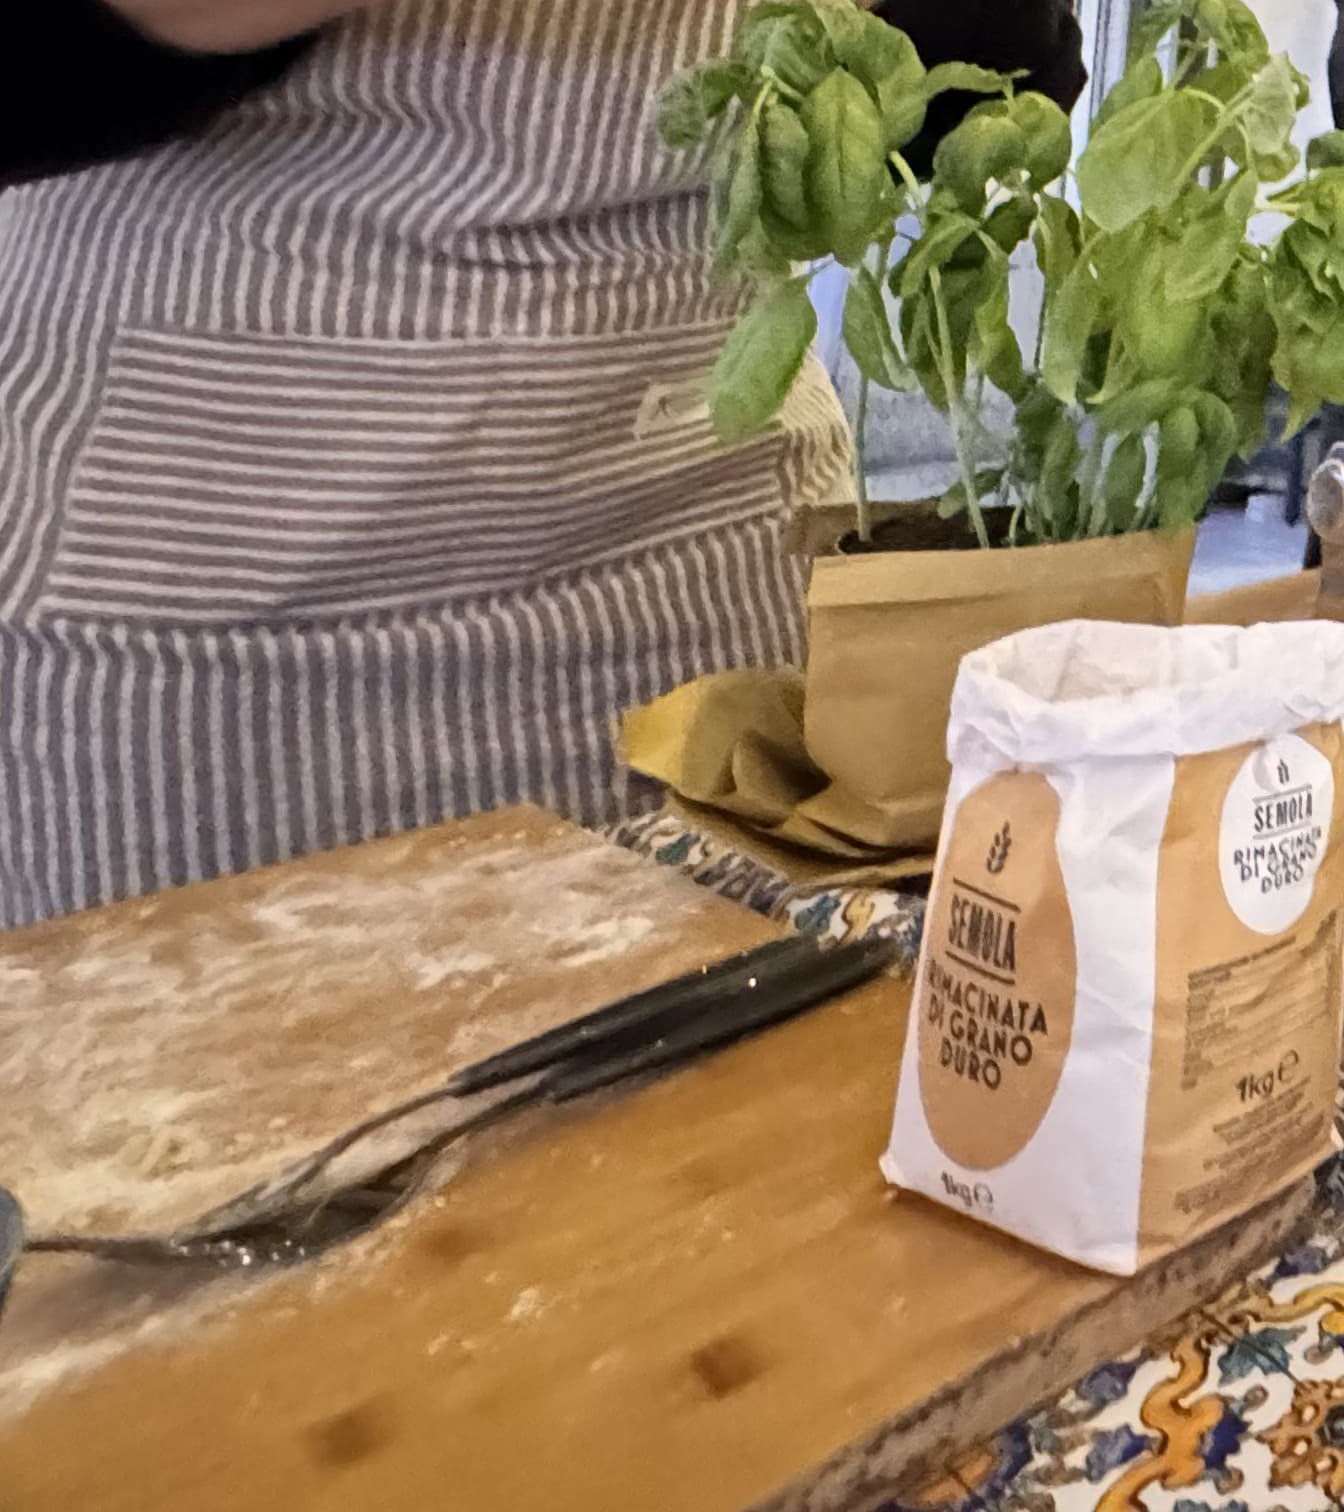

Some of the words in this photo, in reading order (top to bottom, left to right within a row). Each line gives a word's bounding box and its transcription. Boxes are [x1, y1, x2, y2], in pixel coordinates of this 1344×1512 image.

[1254, 791, 1313, 833] SEMOLA
[1241, 861, 1260, 883] DI
[1261, 863, 1304, 894] DURO
[948, 893, 1016, 973] SEMOLA
[928, 958, 1048, 1036] RIMACINATA
[928, 993, 945, 1031] DI
[950, 1009, 1033, 1067] GRANO
[940, 1036, 1002, 1090] DURO
[1236, 1070, 1275, 1103] 1kg
[940, 1171, 973, 1208] 1kg
